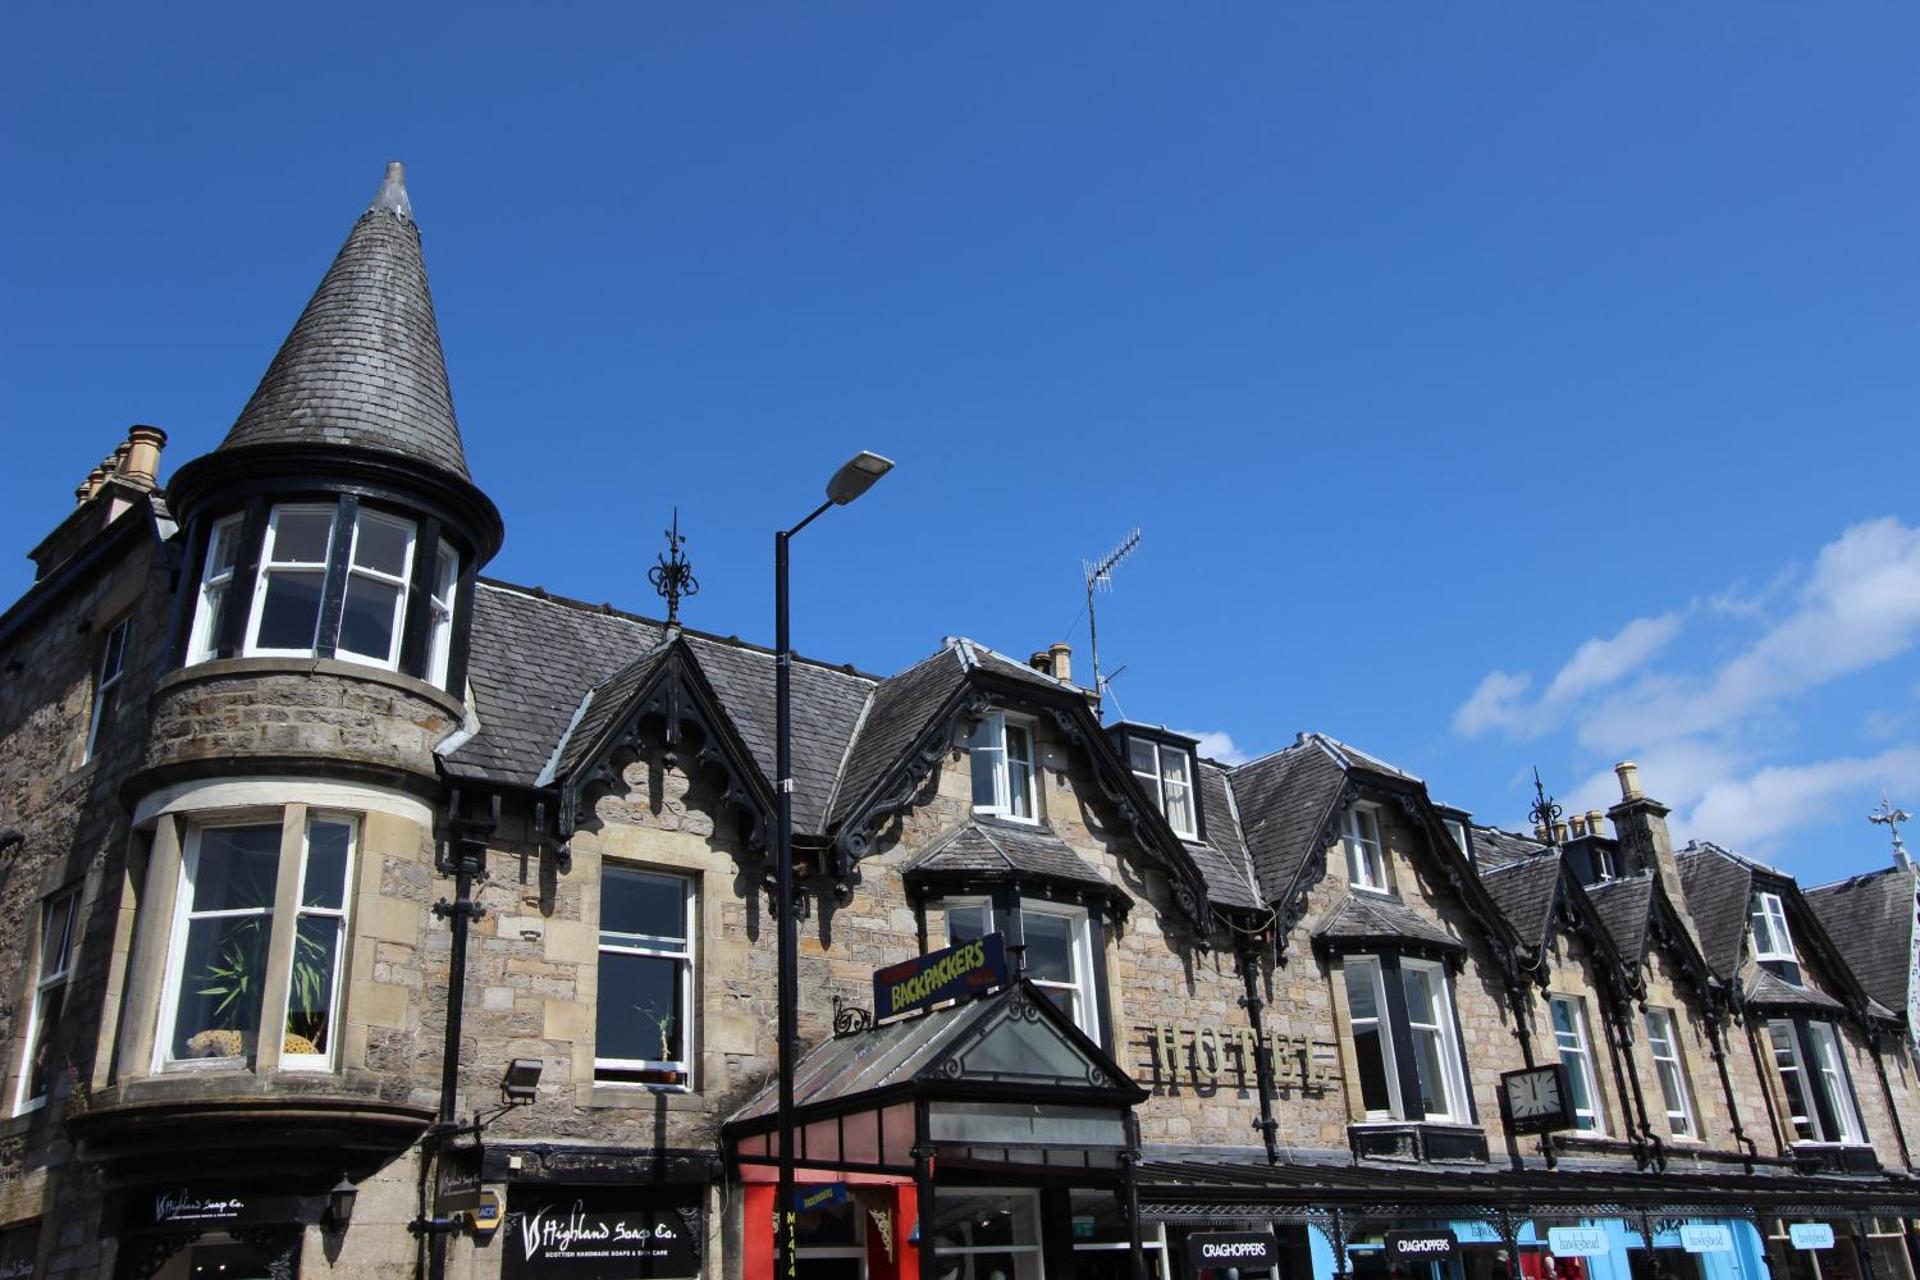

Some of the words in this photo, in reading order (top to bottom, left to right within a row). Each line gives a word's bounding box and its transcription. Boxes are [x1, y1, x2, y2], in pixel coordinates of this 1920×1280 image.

[891, 940, 985, 1012] BACKPACKERS
[1156, 1022, 1331, 1084] HOTEL
[543, 1199, 610, 1250] Highland
[613, 1221, 650, 1248] Soap
[654, 1223, 677, 1239] Co.
[1202, 1242, 1267, 1257] CRAGHOPPERS
[1397, 1238, 1450, 1252] CRAGHOPPERS
